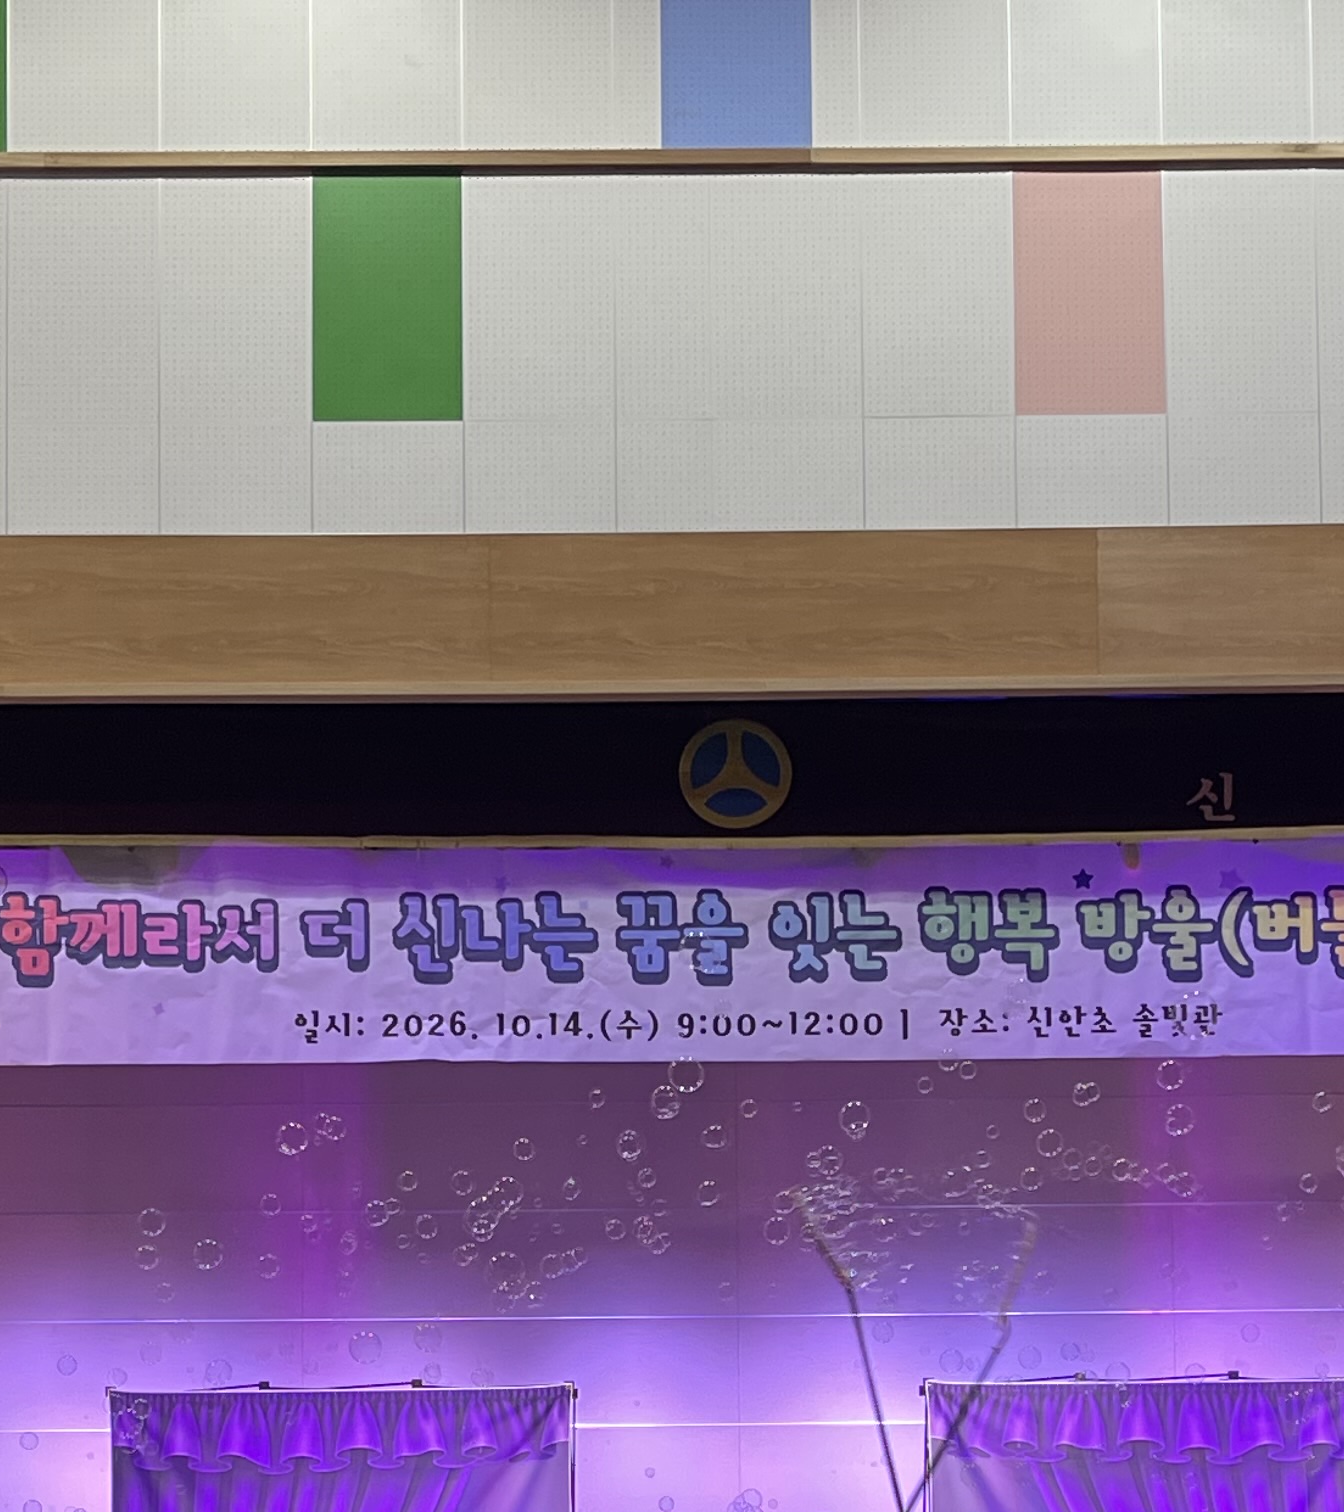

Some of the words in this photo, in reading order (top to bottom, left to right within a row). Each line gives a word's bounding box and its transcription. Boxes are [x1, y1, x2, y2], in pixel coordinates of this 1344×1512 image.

[300, 898, 369, 972] 더
[393, 891, 599, 985] 신나는
[615, 888, 749, 986] 꿈을
[768, 889, 902, 983] 잇는
[918, 886, 1059, 982] 행복
[295, 1011, 364, 1044] 일시:
[381, 1011, 478, 1041] 2026.
[496, 1008, 659, 1042] 10.14.(수)
[677, 1010, 883, 1039] 9:00~12:00
[939, 1007, 1010, 1038] 장소:
[1027, 1004, 1117, 1038] 신안초
[1132, 1003, 1223, 1038] 솔빛관
